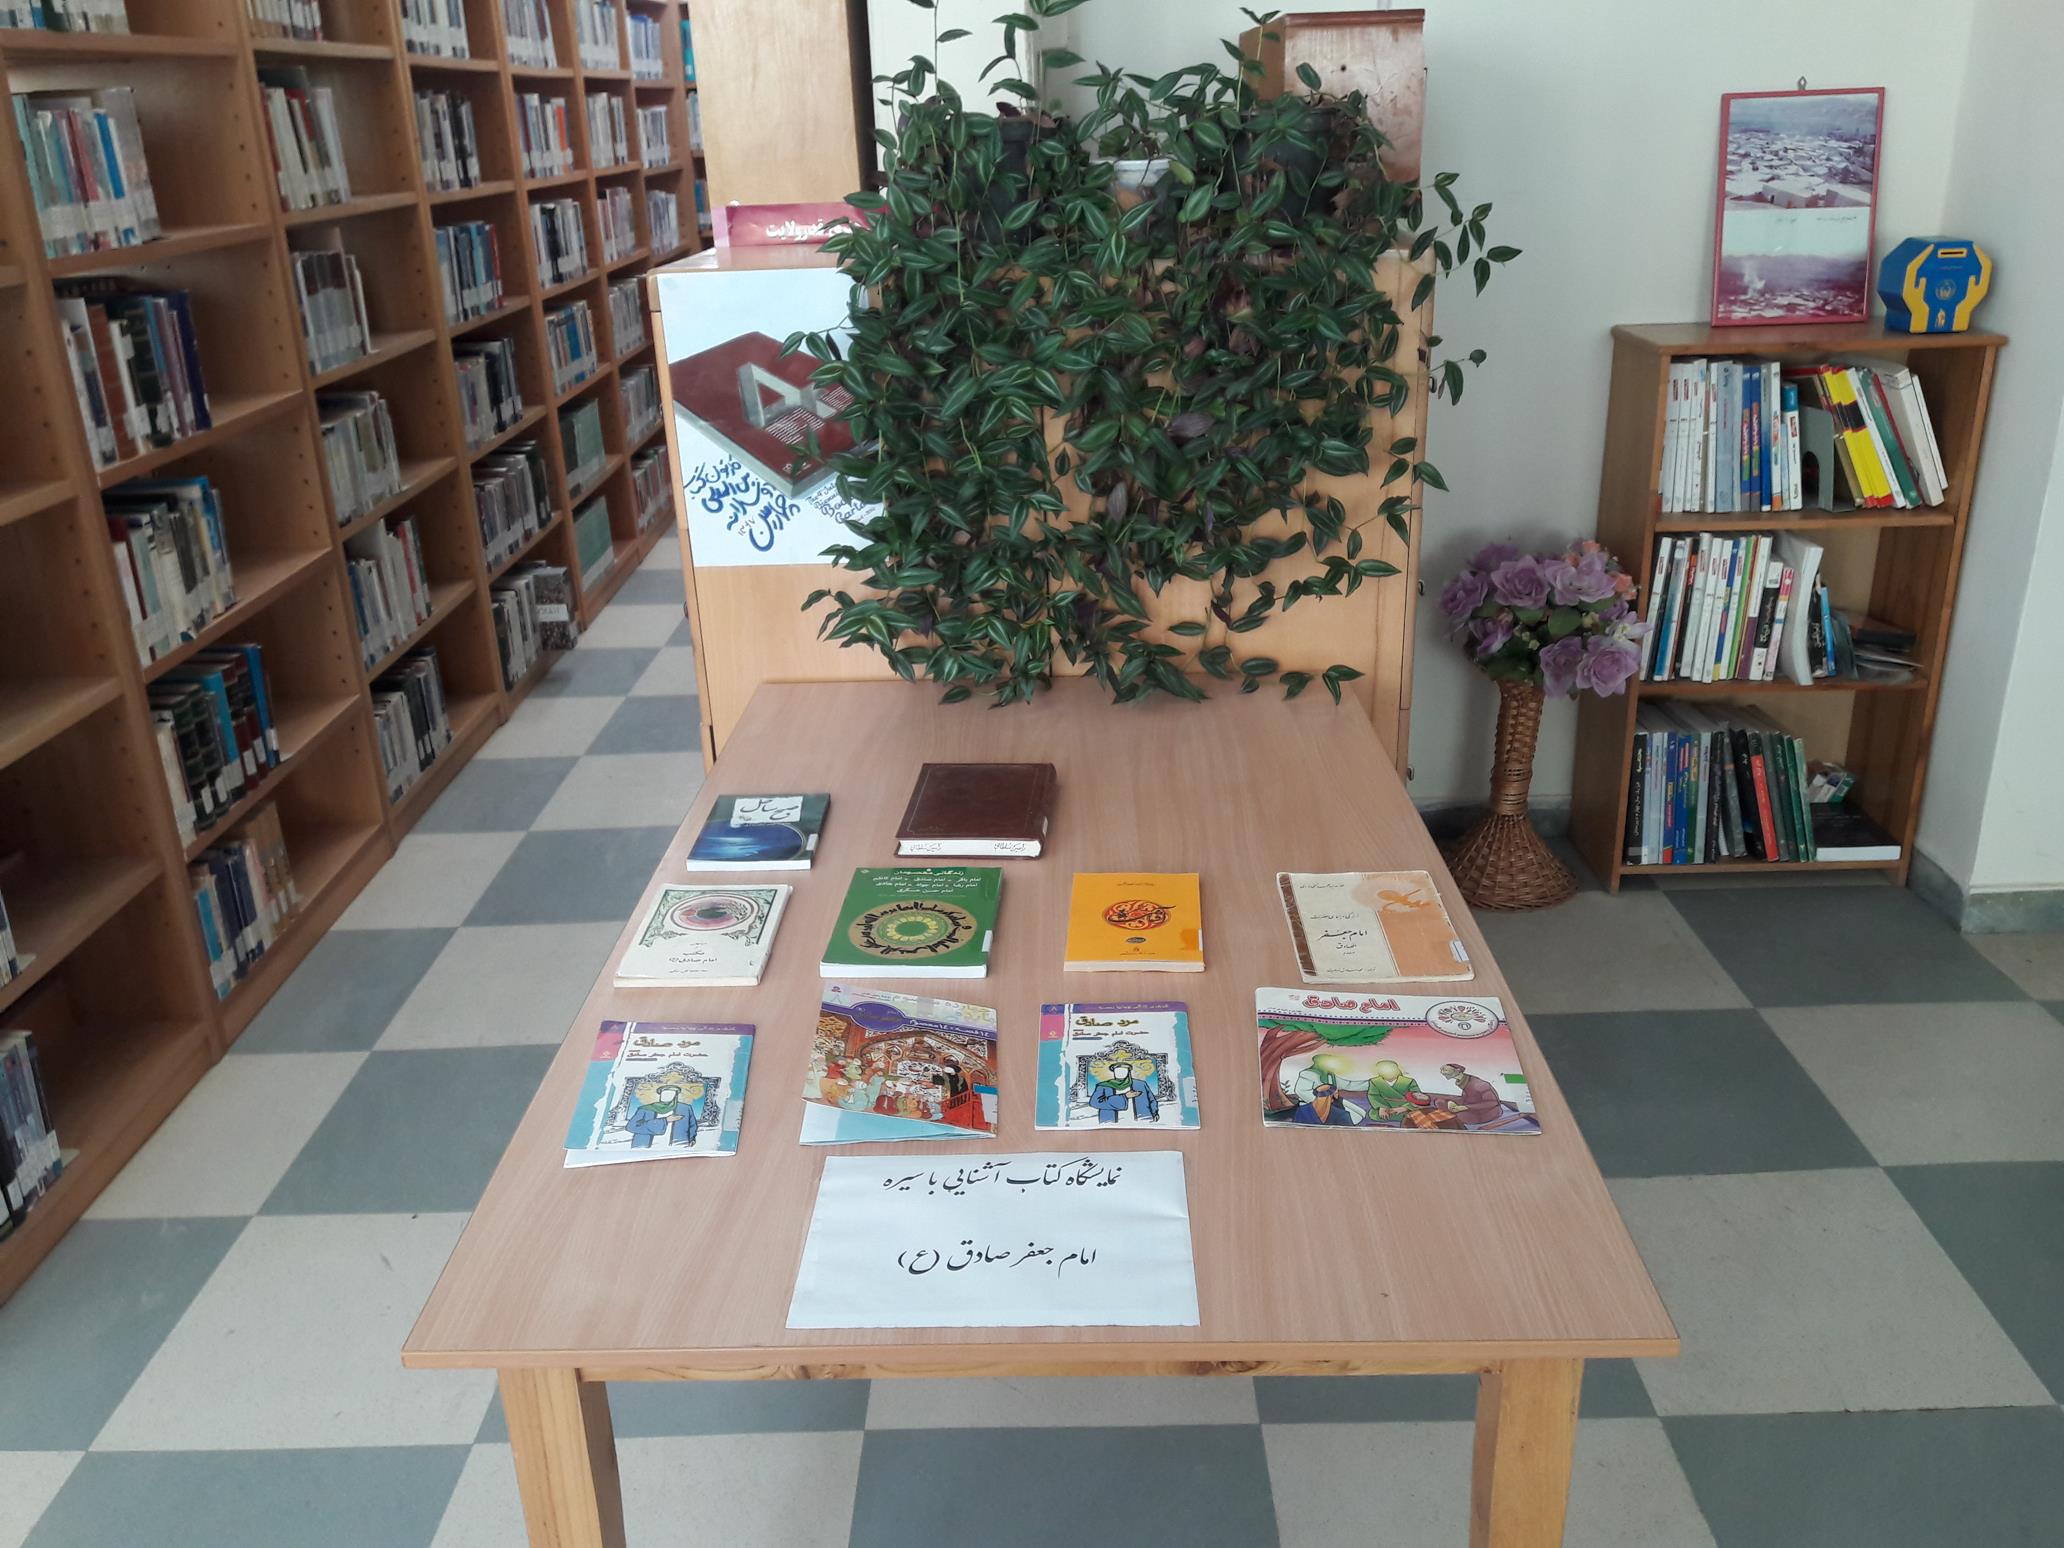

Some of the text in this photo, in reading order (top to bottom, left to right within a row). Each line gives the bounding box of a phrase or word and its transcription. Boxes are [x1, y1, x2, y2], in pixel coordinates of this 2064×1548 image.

[740, 798, 778, 813] ساحل
[769, 805, 799, 820] صبح
[1317, 929, 1368, 942] امام جعفر
[1301, 993, 1358, 1010] صادق
[1359, 997, 1401, 1013] امام
[1075, 1015, 1140, 1028] مرد صادق
[633, 1035, 702, 1049] مرد صادق
[882, 1171, 925, 1192] سیره
[927, 1169, 939, 1195] با
[1006, 1157, 1088, 1194] کتاب
[1065, 1160, 1123, 1188] نمایشگاه
[897, 1239, 1097, 1279] امام جعفر صادق (ع)
